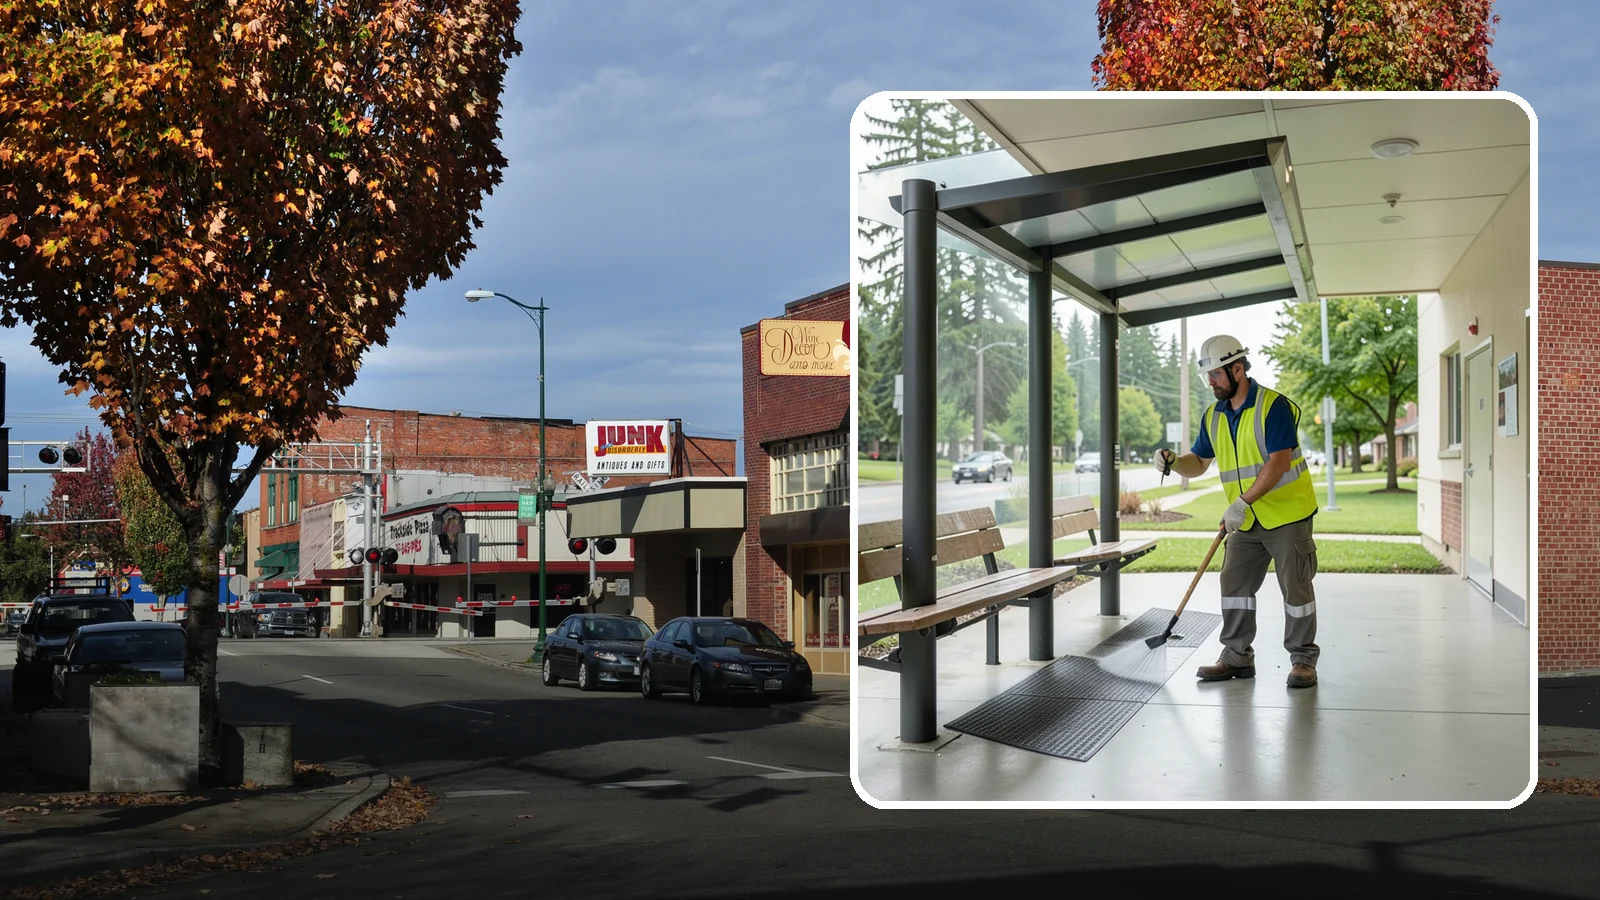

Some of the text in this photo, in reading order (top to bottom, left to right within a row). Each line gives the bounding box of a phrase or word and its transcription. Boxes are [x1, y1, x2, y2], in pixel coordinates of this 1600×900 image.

[764, 327, 831, 365] Decor
[596, 425, 665, 457] JUNK
[608, 446, 645, 454] DISORDERLY
[596, 460, 665, 470] ANTIQUES AND GIFTS
[390, 519, 429, 540] Trackside Pizza
